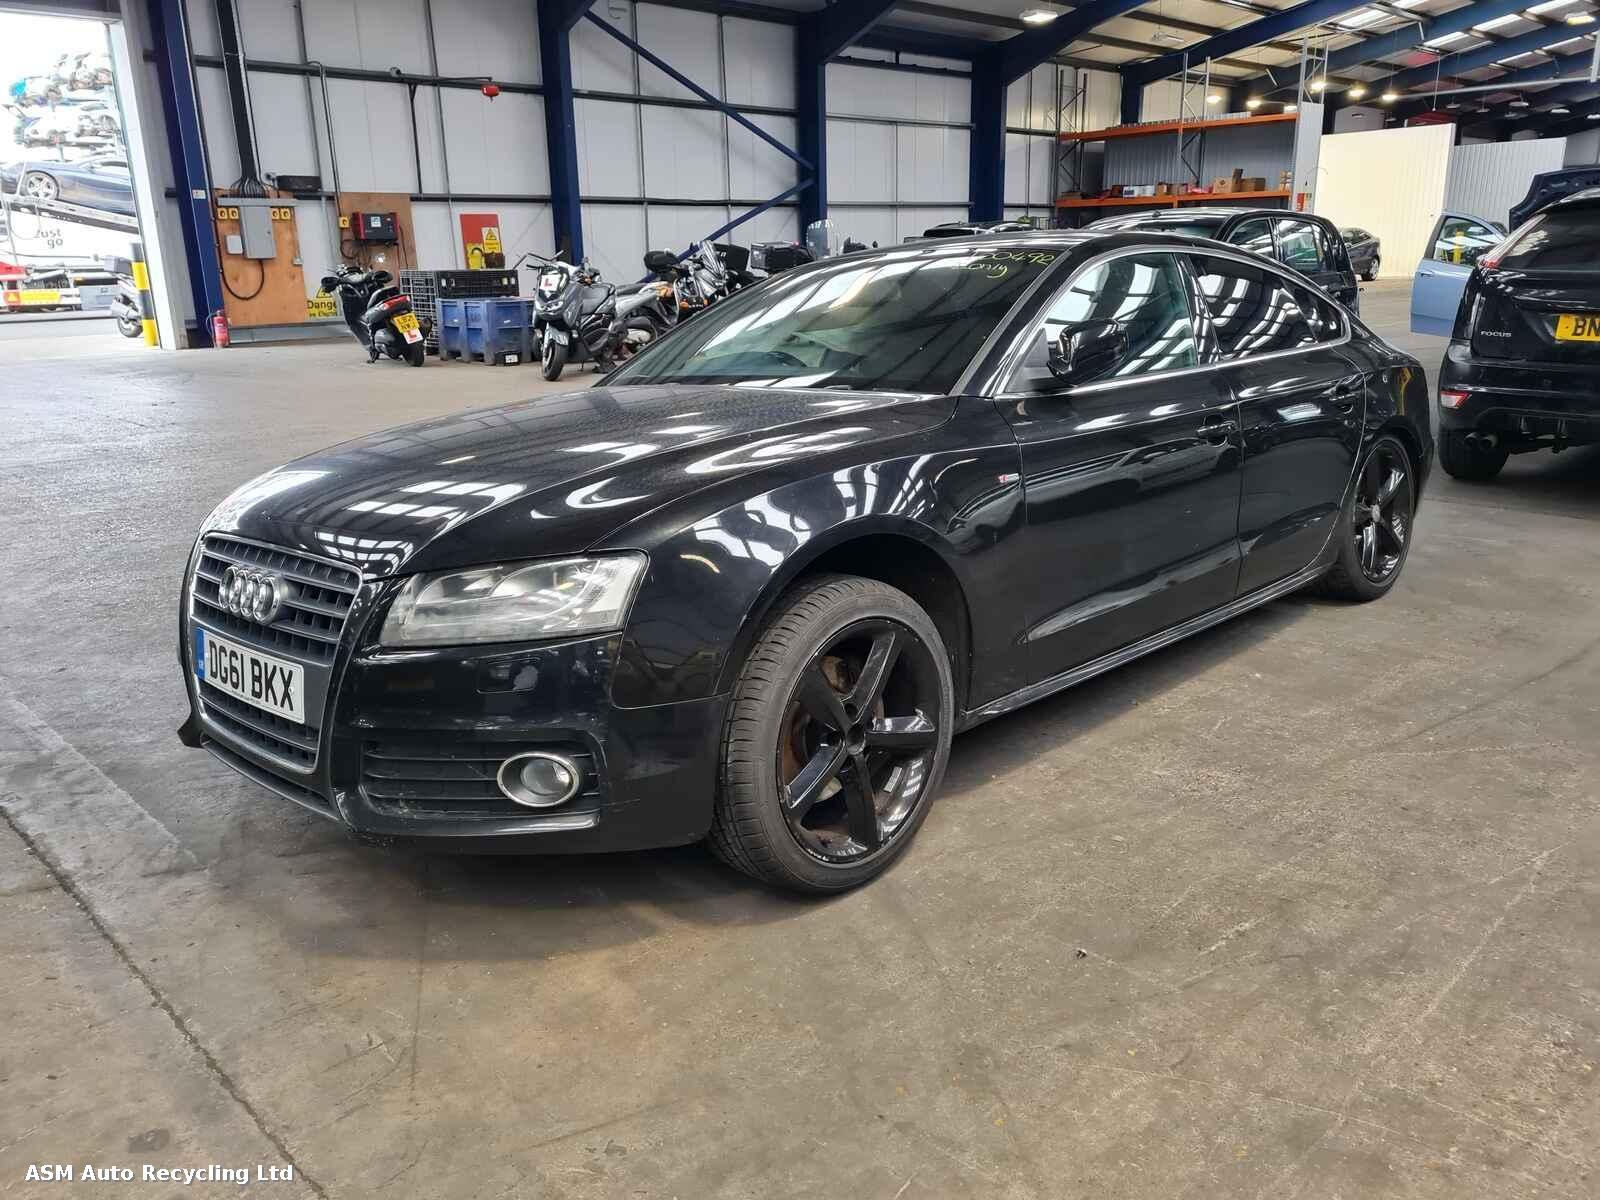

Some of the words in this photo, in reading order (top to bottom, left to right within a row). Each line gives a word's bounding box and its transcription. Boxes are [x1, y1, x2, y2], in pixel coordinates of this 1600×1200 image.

[1480, 330, 1512, 338] FOCUS
[208, 639, 246, 693] DG61
[250, 657, 294, 711] BKX
